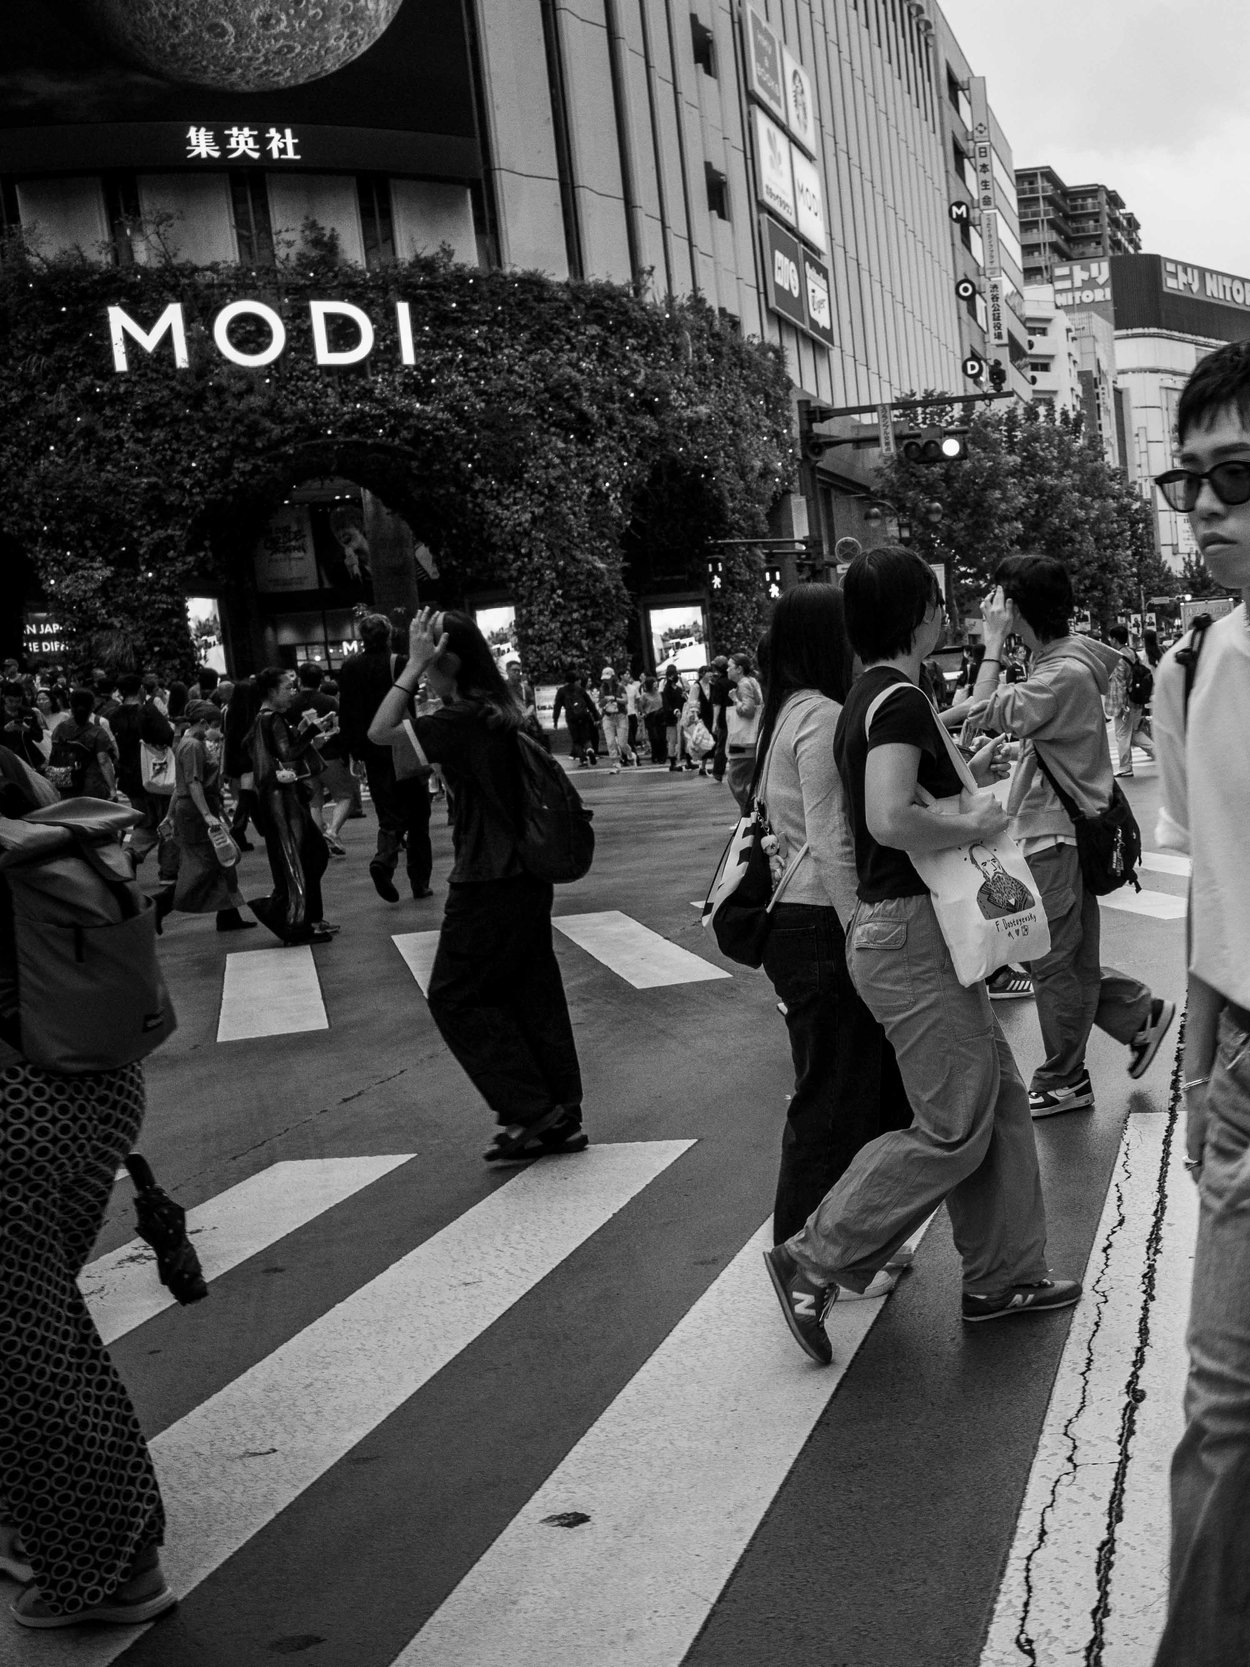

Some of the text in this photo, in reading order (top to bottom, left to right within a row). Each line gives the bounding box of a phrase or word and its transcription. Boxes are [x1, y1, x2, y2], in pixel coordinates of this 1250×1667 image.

[185, 125, 302, 161] 集英社
[978, 147, 992, 206] 日本生命
[1053, 261, 1110, 291] ニトリ
[1165, 261, 1200, 295] ニトリ
[1055, 287, 1112, 307] NITORI
[107, 299, 417, 372] MODI
